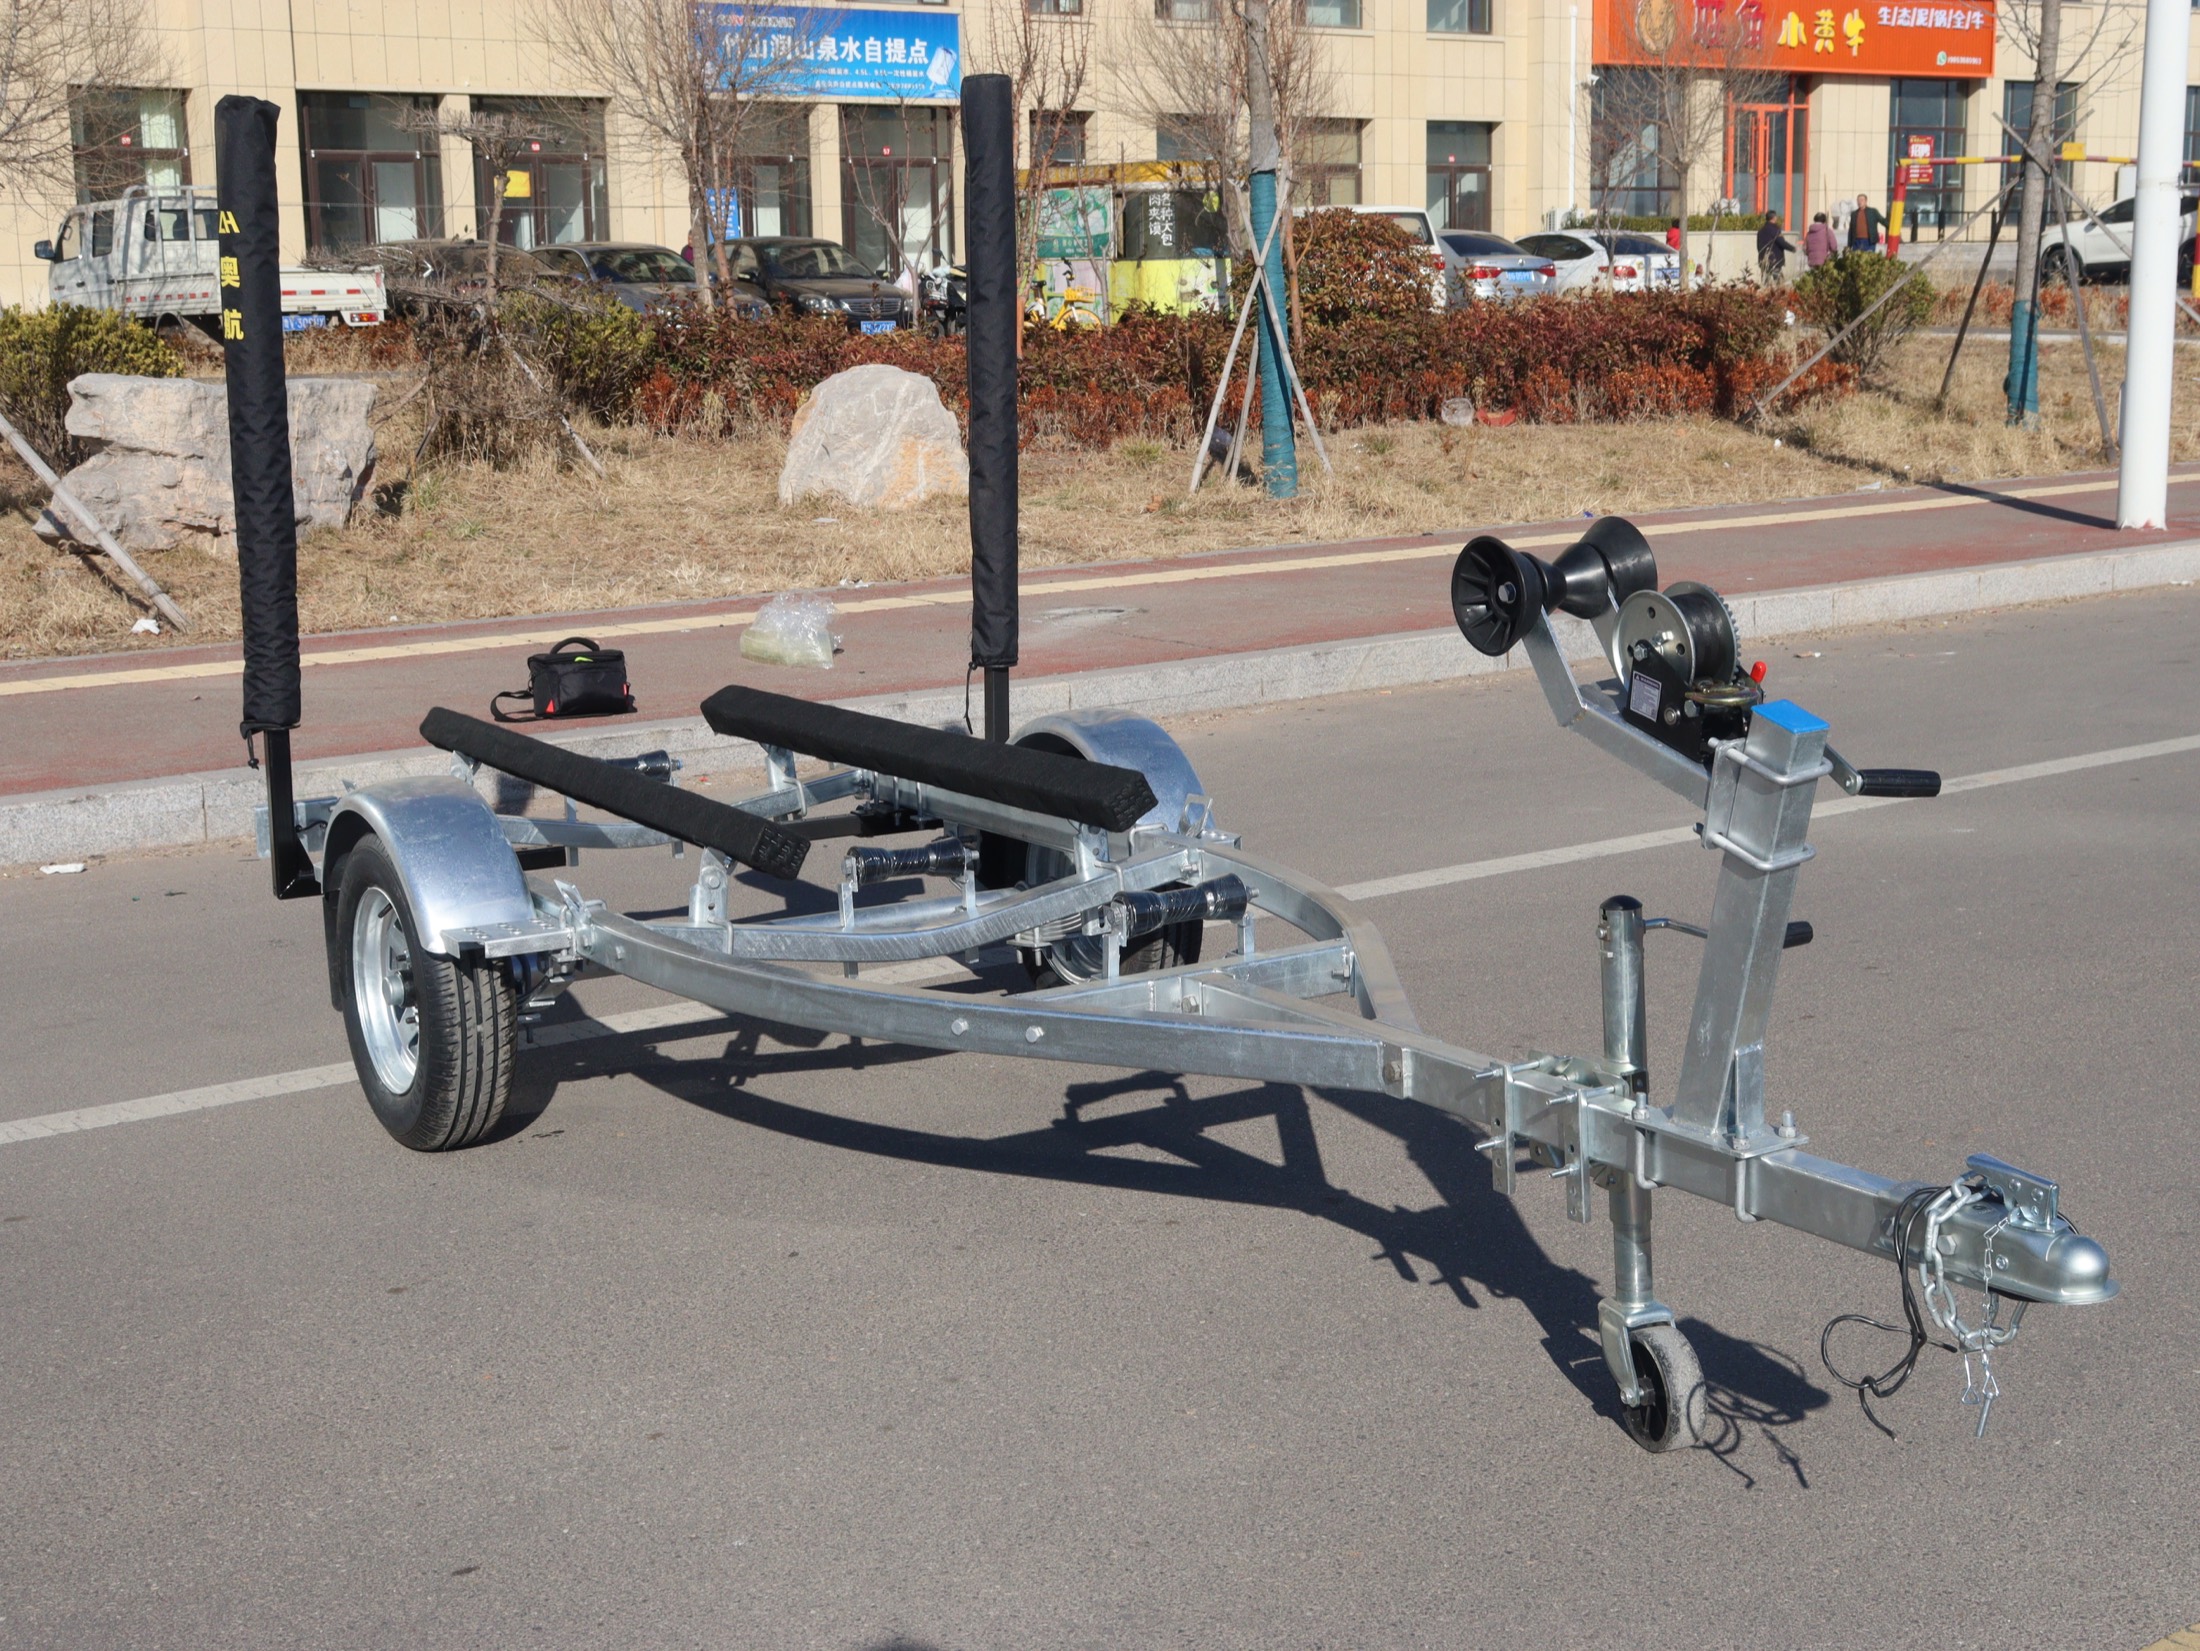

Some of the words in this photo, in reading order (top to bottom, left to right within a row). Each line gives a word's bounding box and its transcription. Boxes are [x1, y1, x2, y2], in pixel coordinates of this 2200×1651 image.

[1777, 8, 1866, 57] 小黄牛
[1160, 192, 1174, 247] 各种大包
[220, 255, 245, 341] 奥航
